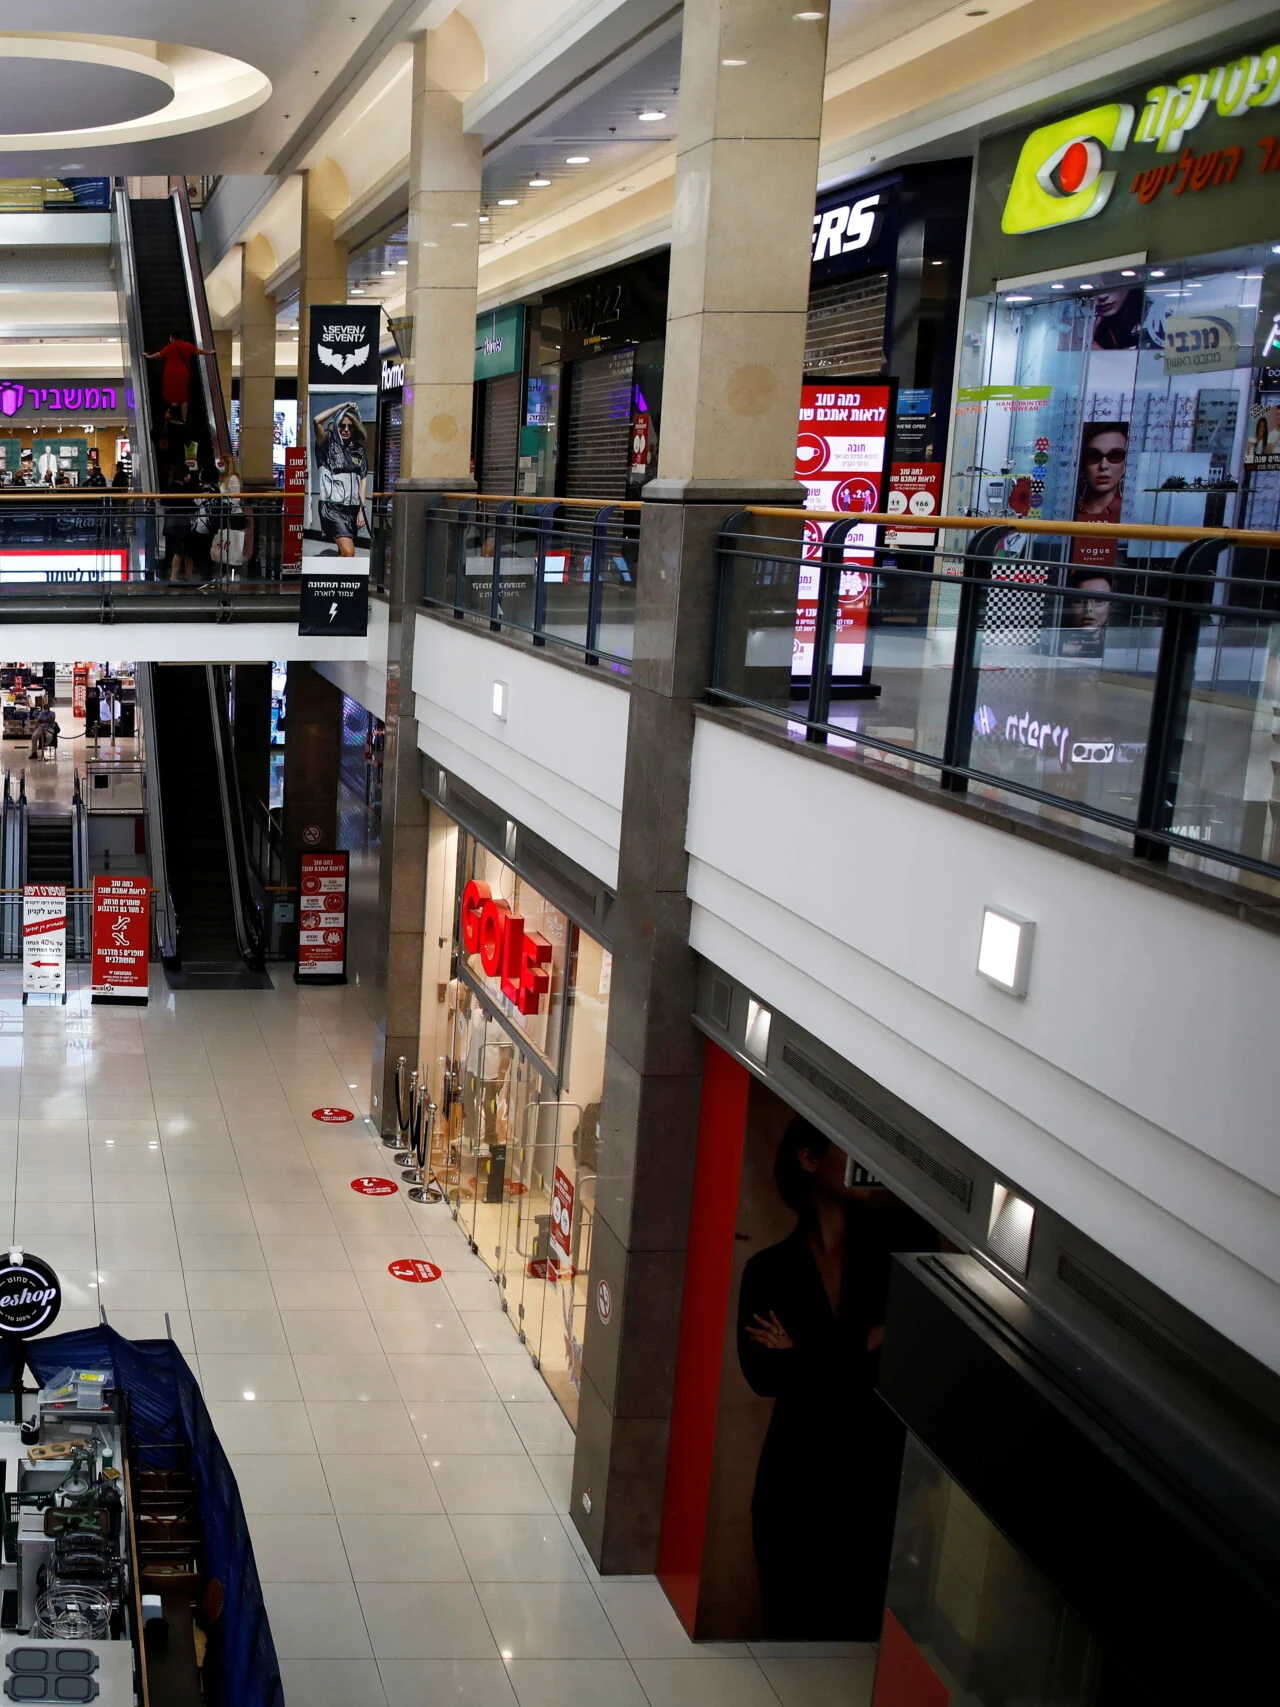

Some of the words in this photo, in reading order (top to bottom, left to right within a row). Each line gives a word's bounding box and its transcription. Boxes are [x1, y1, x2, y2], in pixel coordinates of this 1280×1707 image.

[1130, 146, 1244, 205] השלישי
[328, 325, 360, 334] SEVEN
[322, 333, 365, 342] SEVENTY
[1167, 326, 1220, 353] מכבי
[28, 387, 116, 410] המשביר
[815, 393, 835, 406] טוב
[837, 393, 860, 406] כמה
[799, 408, 814, 422] שו
[816, 408, 849, 422] אתכם
[850, 407, 886, 422] לראות
[847, 444, 866, 452] חובה
[1080, 547, 1111, 556] vogue
[103, 898, 119, 906] מרחק
[27, 907, 46, 915] לקניון
[97, 948, 119, 956] מדרגות
[462, 880, 552, 1015] GOLF
